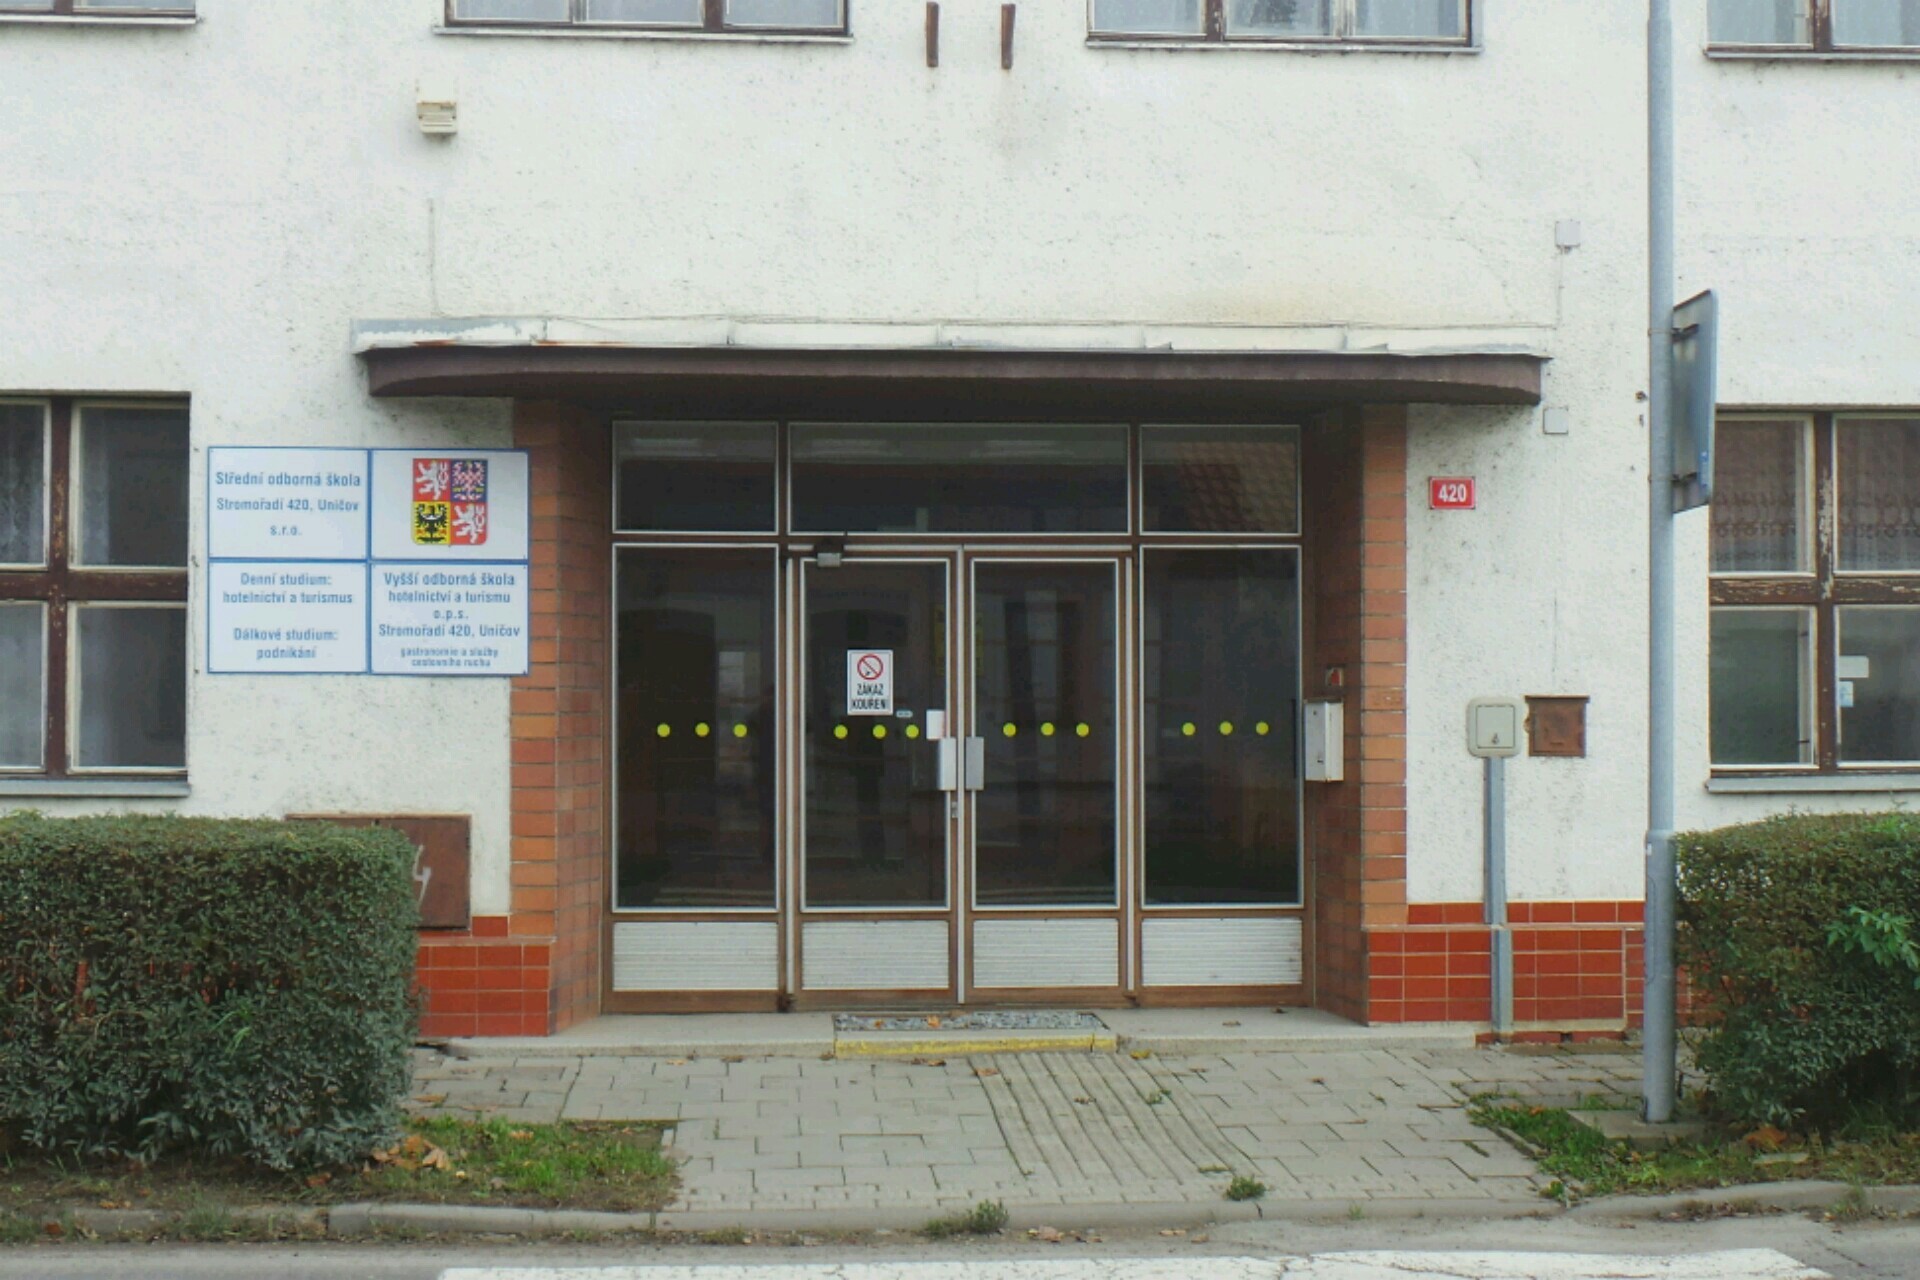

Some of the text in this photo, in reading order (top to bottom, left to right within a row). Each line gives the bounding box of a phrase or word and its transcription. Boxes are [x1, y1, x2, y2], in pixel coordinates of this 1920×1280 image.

[216, 471, 361, 487] Střední odborná škola
[1438, 484, 1467, 502] 420
[216, 497, 359, 512] Stromořadí 420, Uničov
[270, 525, 302, 536] s.r.o.
[240, 572, 333, 586] Denní studium:
[384, 572, 515, 587] Vyšší odborná škola
[223, 591, 353, 604] hotelnictví a turismus
[388, 590, 511, 603] hotelnictví a turismu
[433, 609, 469, 620] o.p.s.
[233, 627, 338, 641] Dálkové studium:
[379, 623, 520, 638] Stromořadí 420, Uničov
[256, 646, 317, 660] podnikání
[857, 682, 884, 696] ZÁKAZ
